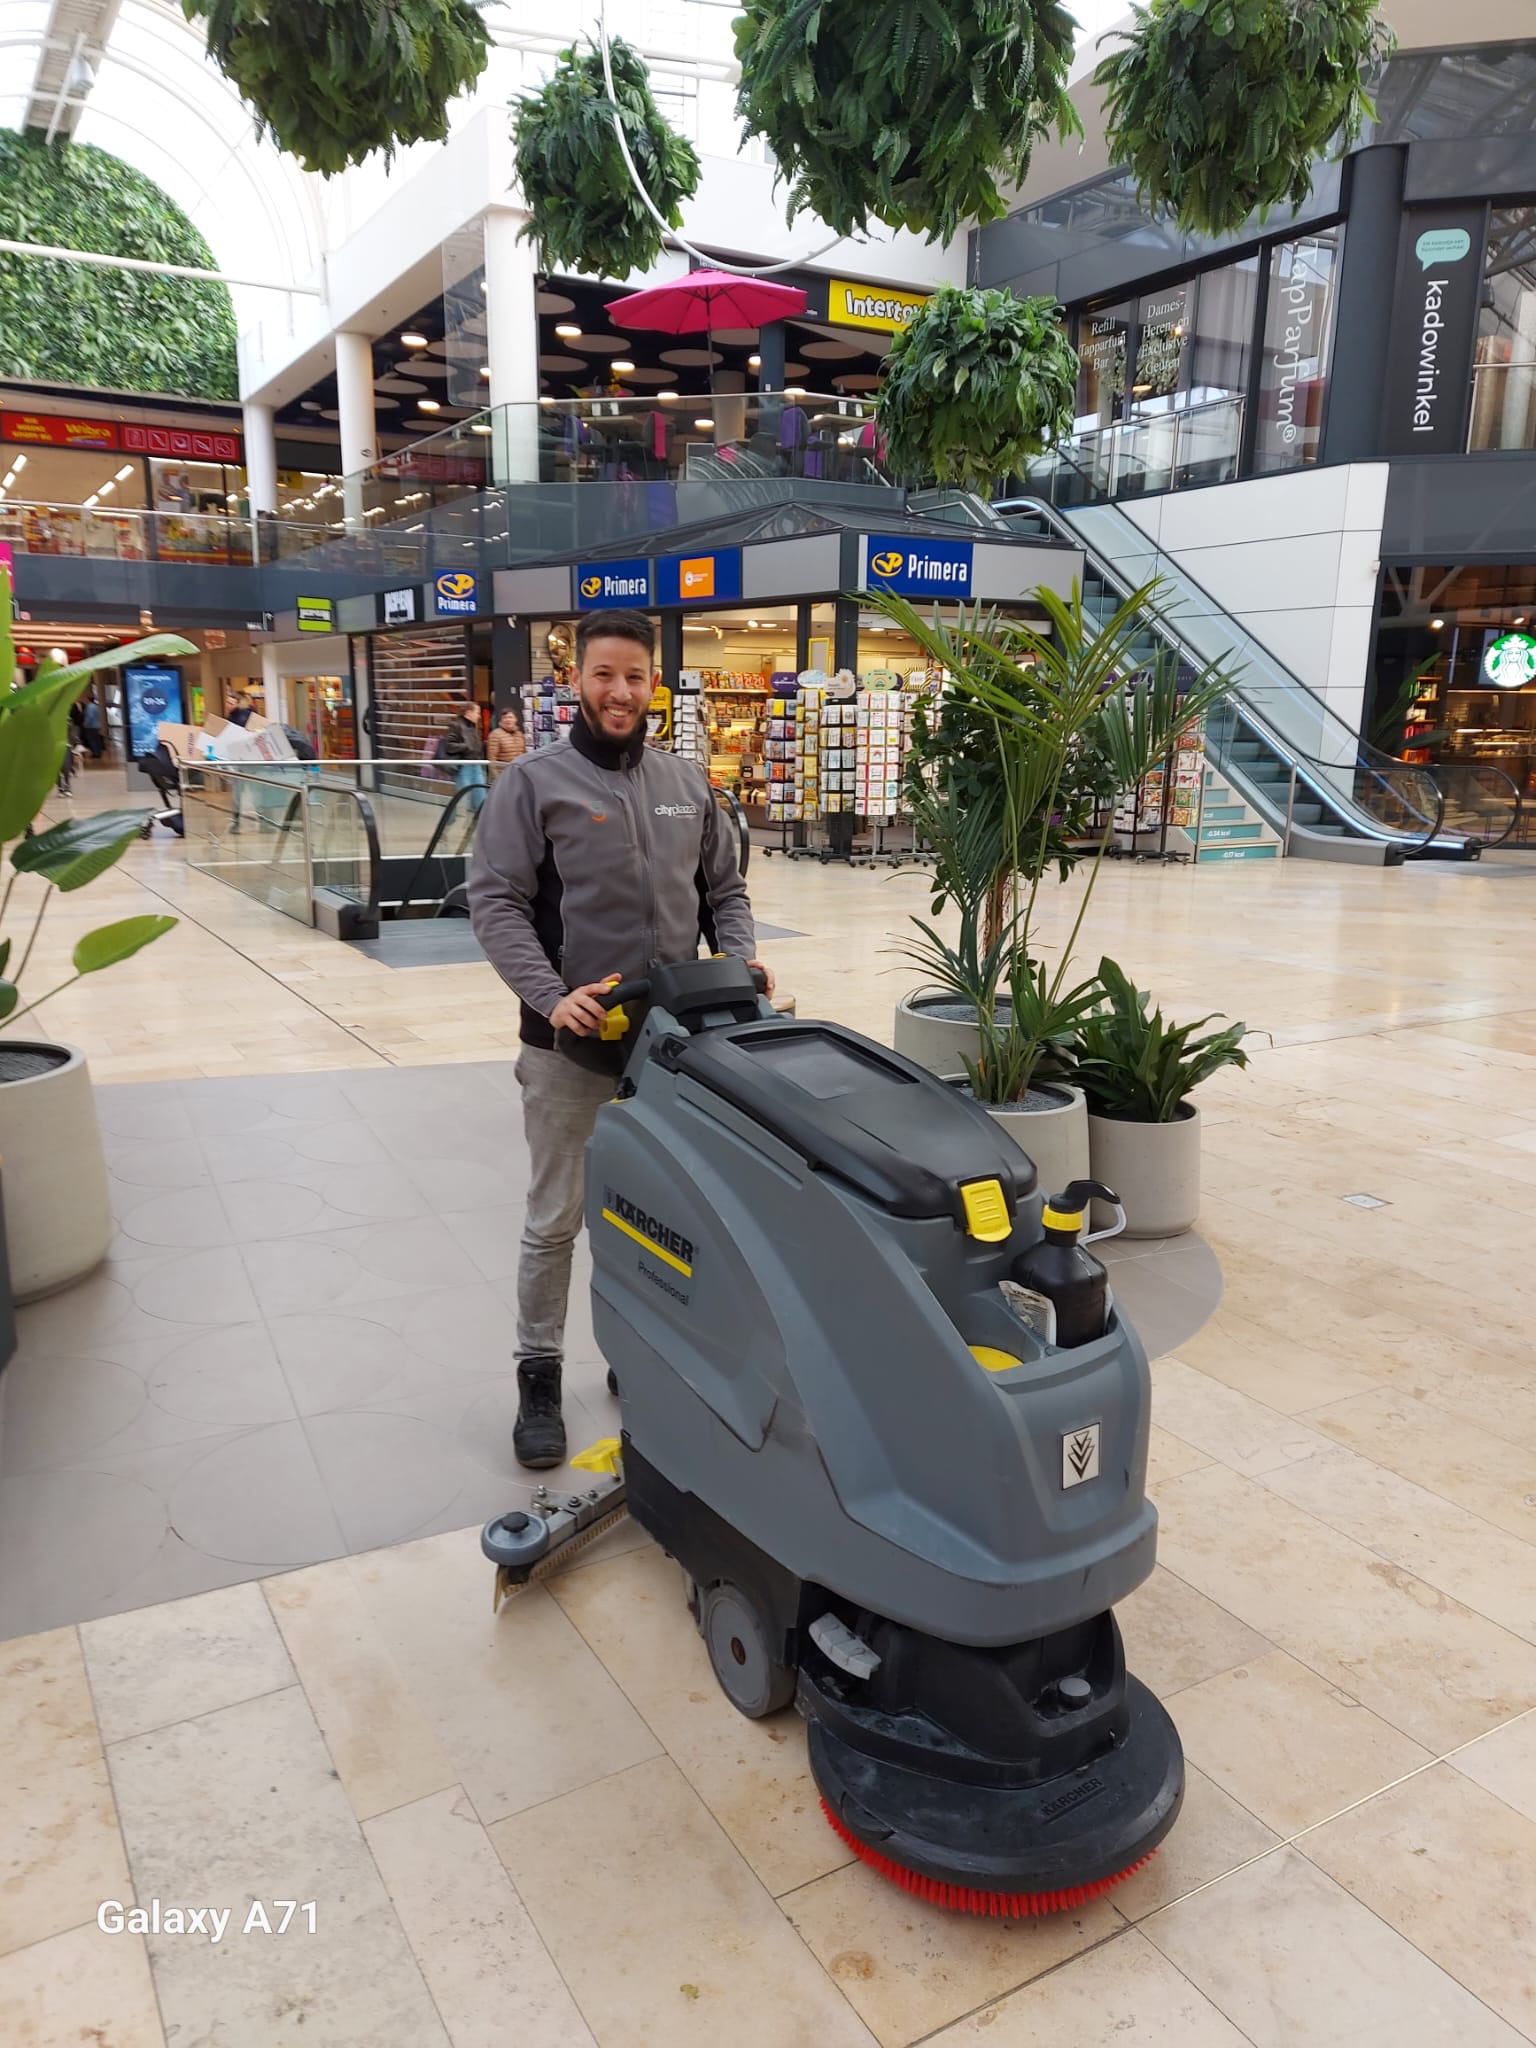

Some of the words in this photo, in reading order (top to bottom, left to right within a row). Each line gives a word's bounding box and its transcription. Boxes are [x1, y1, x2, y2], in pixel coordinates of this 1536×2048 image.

[844, 288, 923, 322] Interto
[1091, 316, 1116, 337] Refill
[1141, 335, 1188, 358] Exclusive
[1412, 279, 1449, 432] kadowinkel
[1093, 358, 1109, 371] Bar
[908, 553, 968, 582] Primera
[604, 575, 647, 597] Primera
[436, 596, 477, 612] Primera
[637, 1259, 689, 1306] Professional
